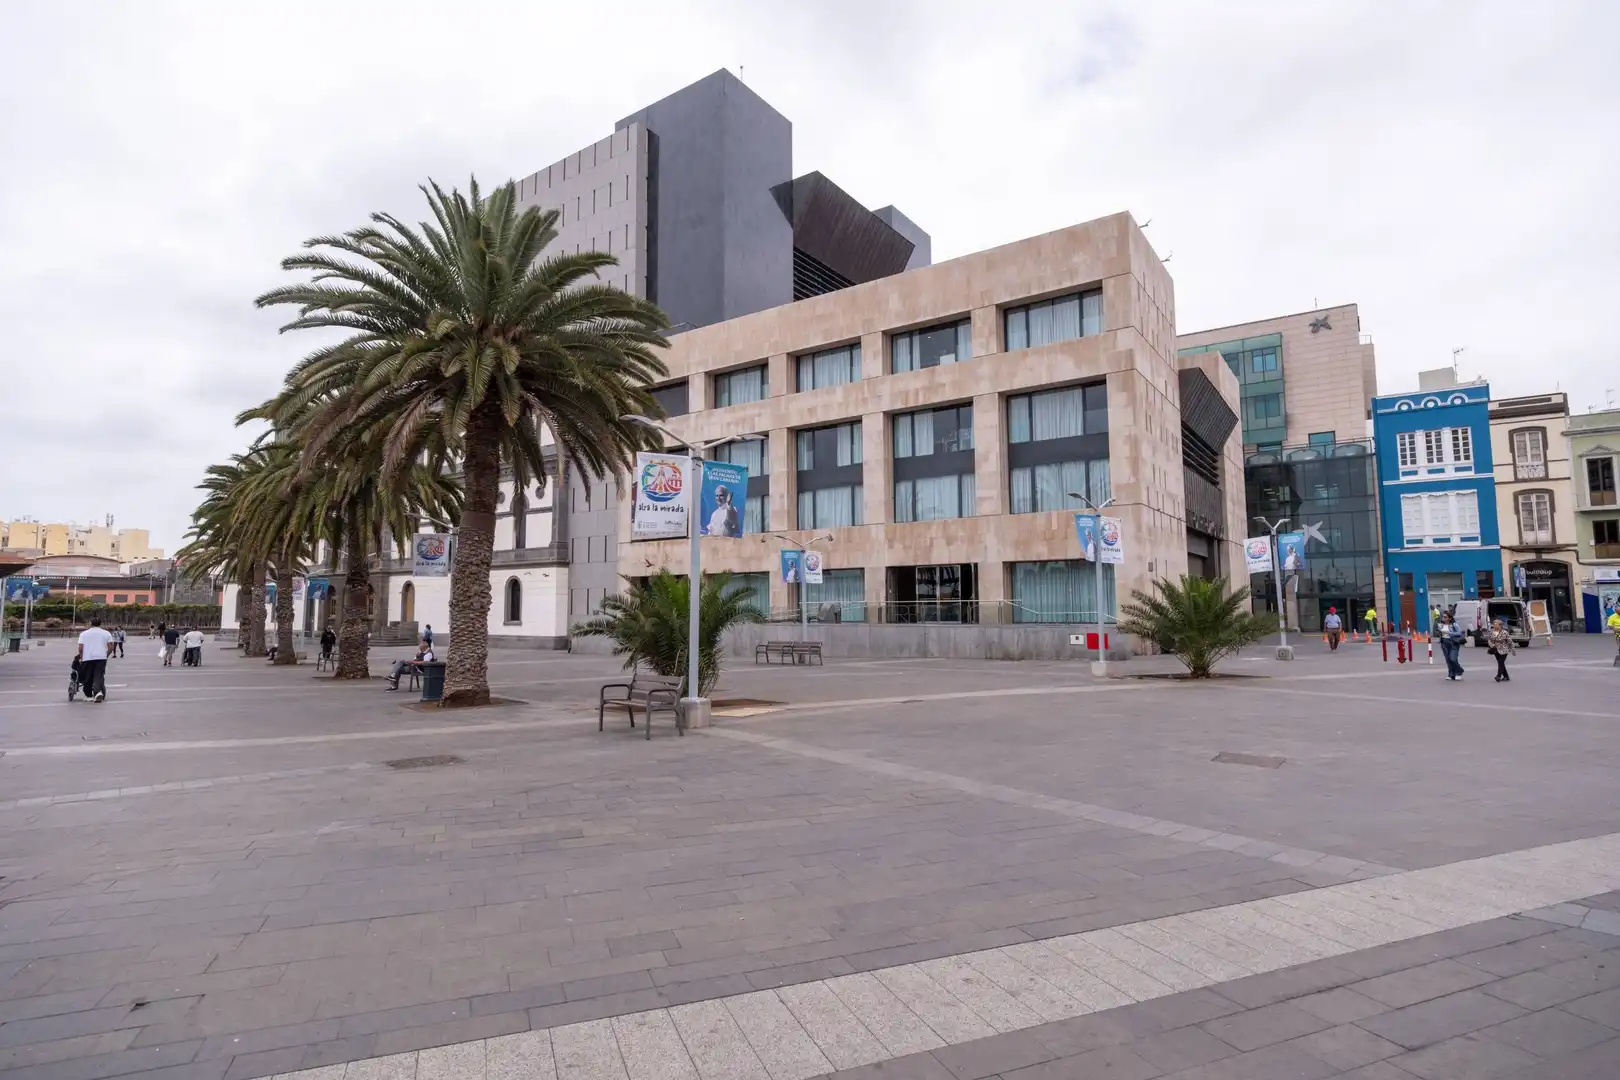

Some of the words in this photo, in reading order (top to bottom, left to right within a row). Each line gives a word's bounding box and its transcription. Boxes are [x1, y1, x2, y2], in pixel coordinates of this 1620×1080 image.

[638, 503, 650, 511] alza
[652, 503, 658, 511] la
[660, 503, 684, 513] mirada
